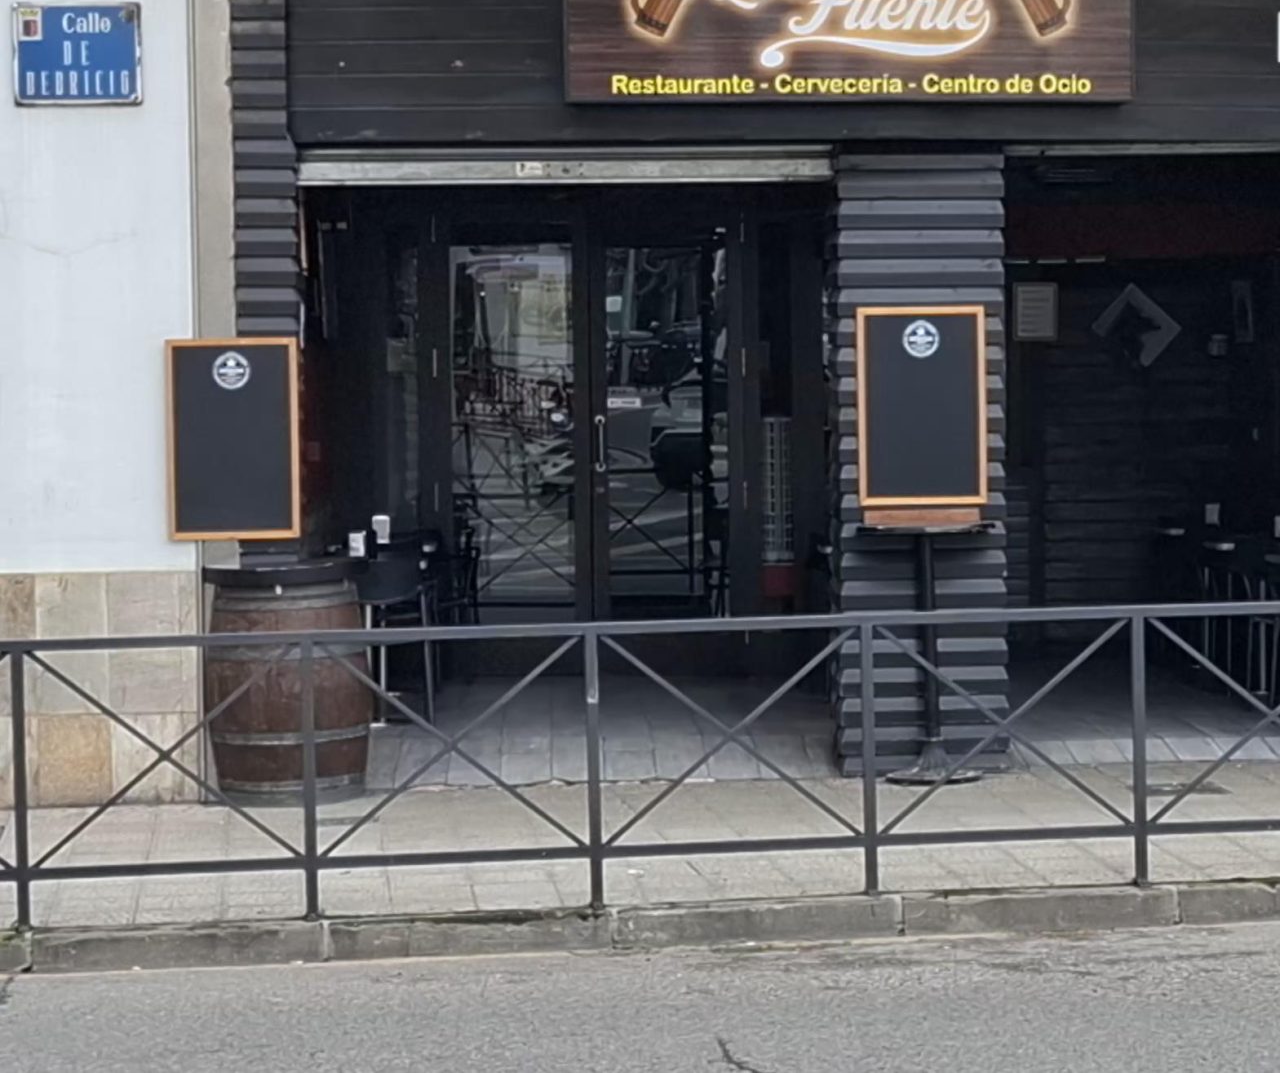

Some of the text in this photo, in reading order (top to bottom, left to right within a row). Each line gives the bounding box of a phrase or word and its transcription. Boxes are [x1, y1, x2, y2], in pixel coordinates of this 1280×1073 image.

[62, 12, 111, 33] Calle
[63, 40, 90, 66] DE
[612, 74, 754, 94] Restaurante
[922, 73, 999, 94] Centro
[1005, 73, 1033, 94] de
[1039, 73, 1091, 94] Ocio
